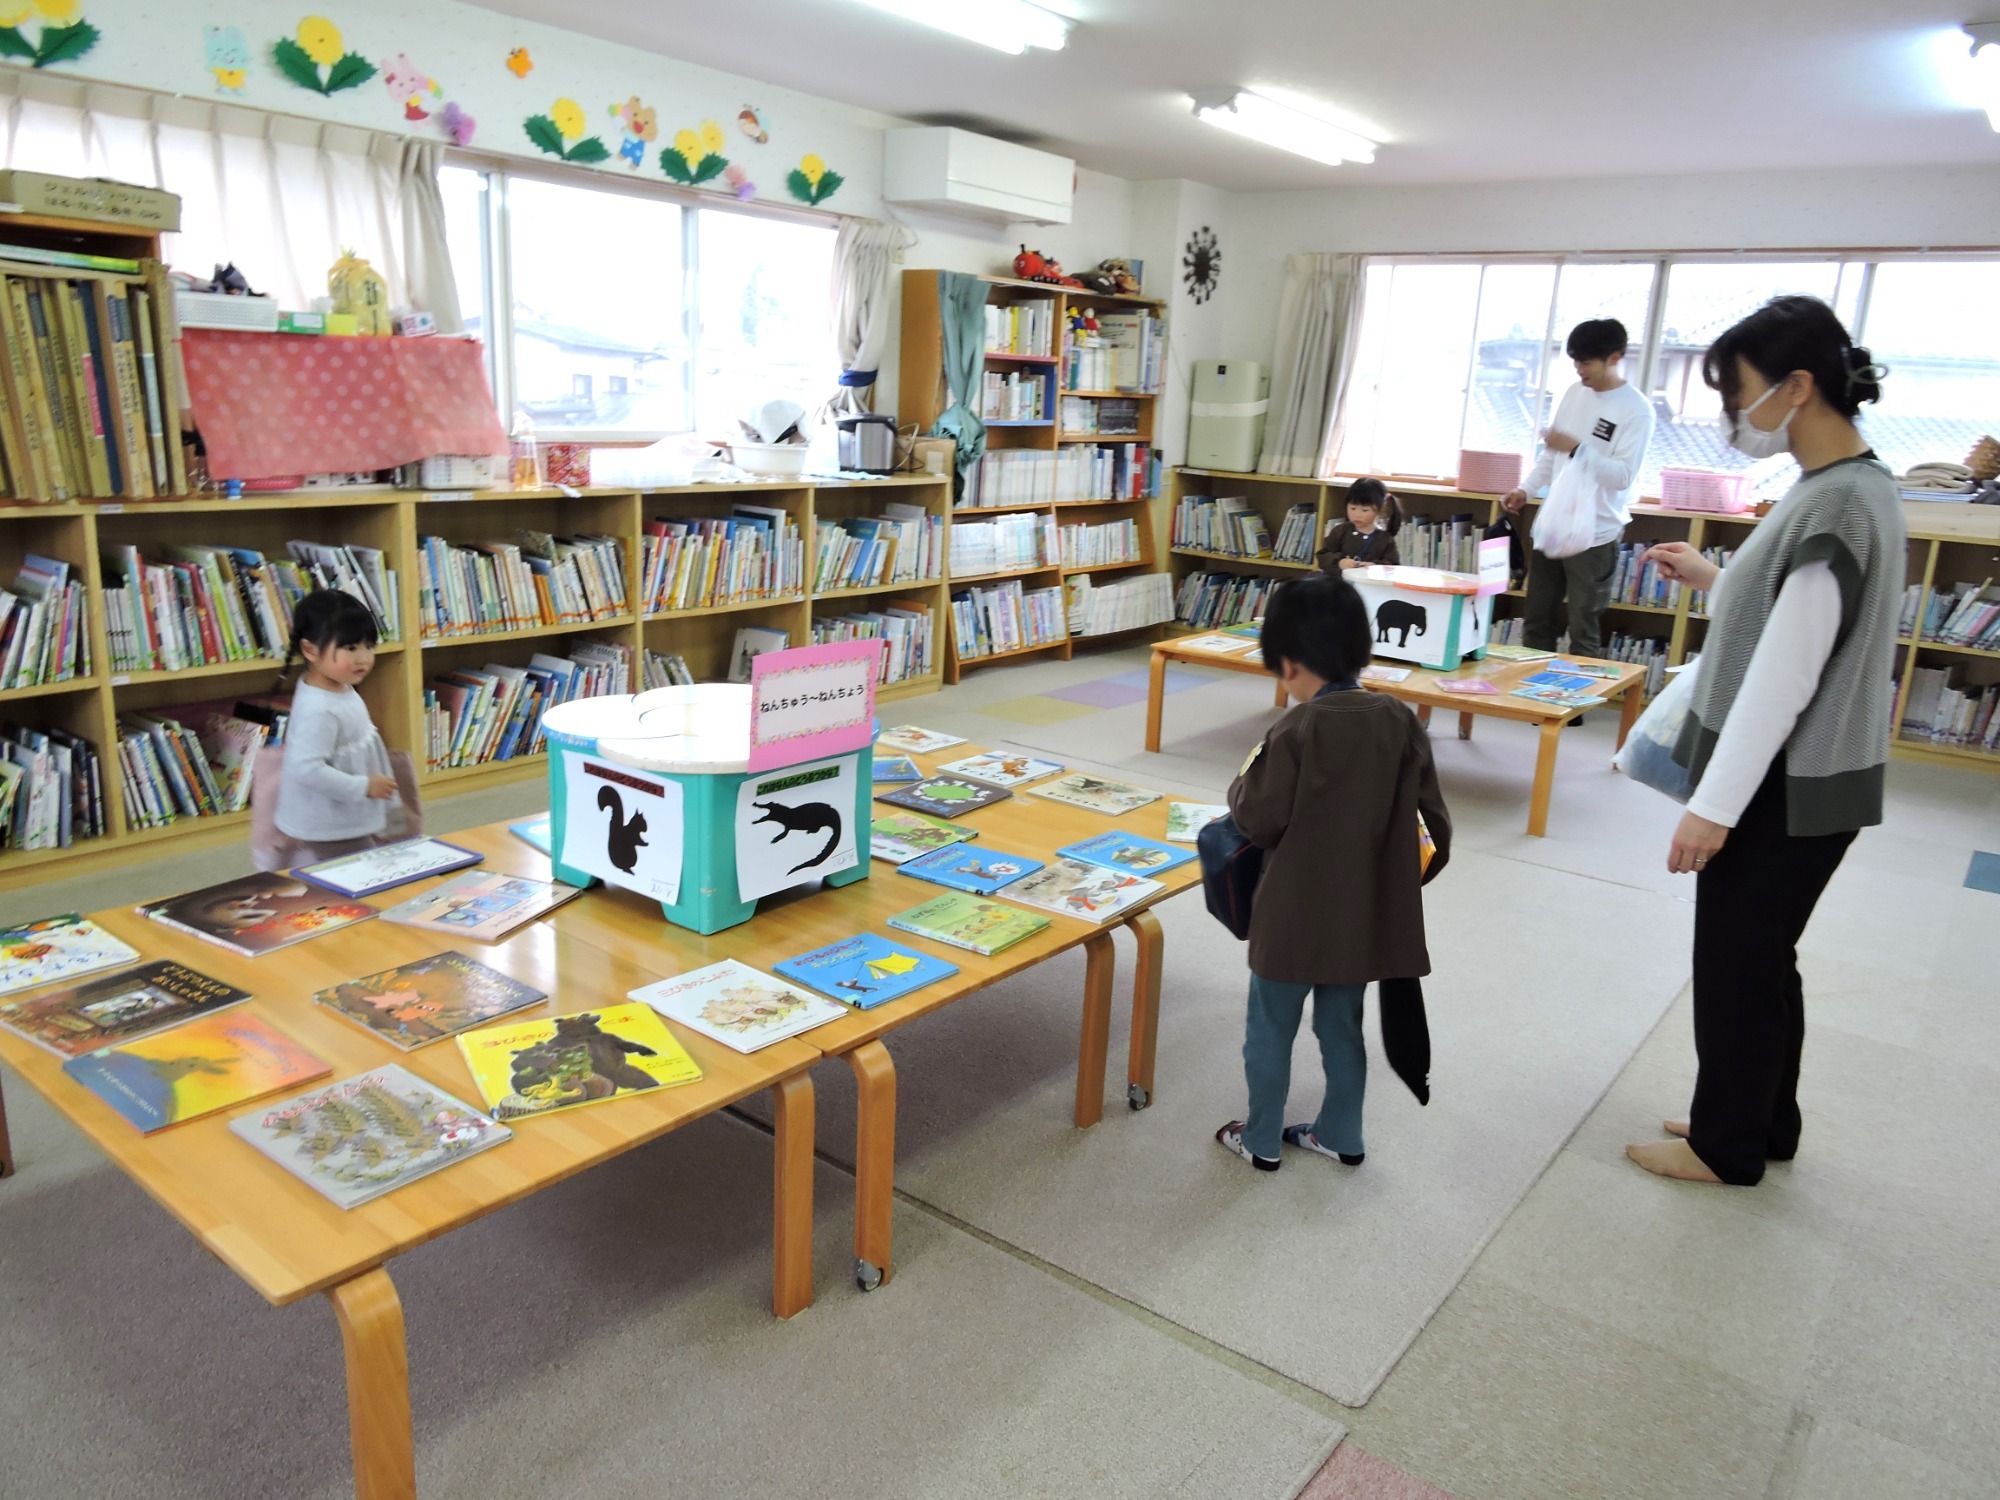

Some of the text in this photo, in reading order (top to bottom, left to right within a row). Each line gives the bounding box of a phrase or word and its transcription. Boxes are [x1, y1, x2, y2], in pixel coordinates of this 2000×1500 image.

[760, 684, 865, 713] ねんちゅう～ねんちょう
[602, 1015, 635, 1026] くま
